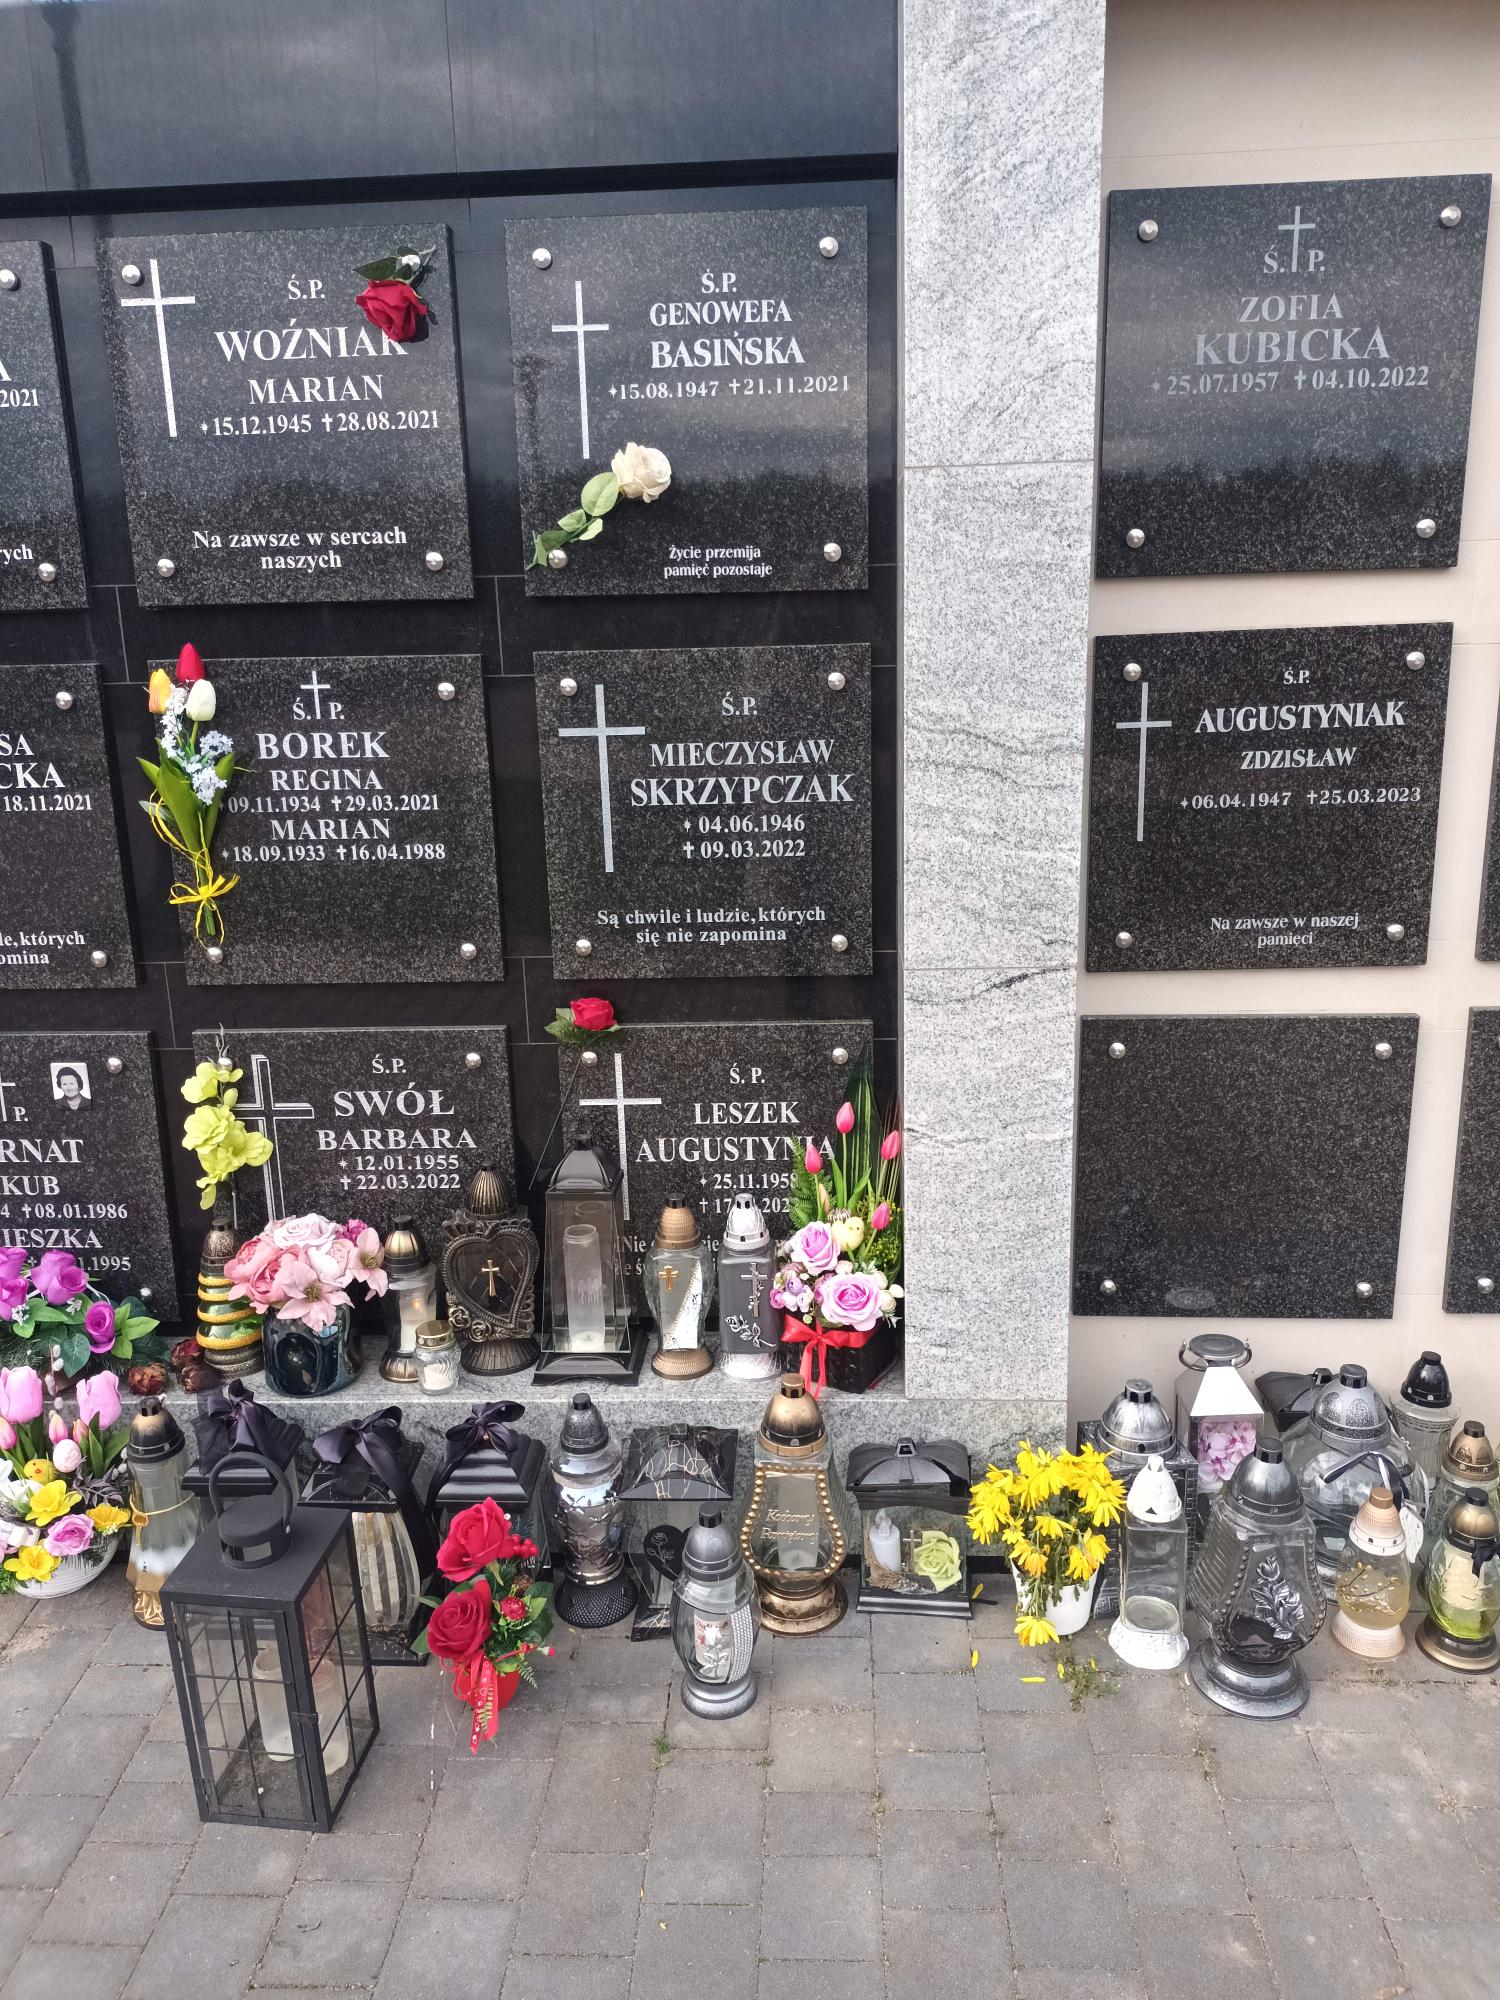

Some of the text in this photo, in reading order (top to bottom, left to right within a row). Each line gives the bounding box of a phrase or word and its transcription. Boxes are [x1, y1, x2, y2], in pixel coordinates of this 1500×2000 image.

[1263, 245, 1325, 274] Ś. P.
[287, 274, 326, 301] Ś.P.
[701, 268, 737, 294] Ś.P.
[649, 299, 792, 327] GENOWEFA
[1238, 293, 1344, 322] ZOFIA
[214, 318, 409, 362] WOŹNIAK
[651, 330, 805, 369] BASIŃSKA
[1194, 326, 1390, 366] KUBICKA
[248, 374, 384, 405] MARIAN
[620, 375, 849, 400] 15.08.1947 21.11.2021
[1166, 366, 1429, 395] 25.07.1957 04.10.2022
[212, 410, 440, 436] 15.12.1945 28.08.2021
[193, 527, 407, 549] Na zawsze w sercach
[0, 543, 34, 565] ych
[261, 552, 342, 573] naszych
[669, 545, 761, 563] Życie przemija
[664, 562, 772, 579] pamięć pozostaje
[1283, 667, 1310, 685] Ś.P.
[293, 697, 345, 721] Ś. P.
[721, 691, 758, 716] Ś.P.
[1195, 701, 1405, 733] AUGUSTYNIAK
[256, 731, 390, 760] BOREK
[649, 739, 834, 767] MIECZYSŁAW
[1241, 747, 1357, 770] ZDZISŁAW
[271, 770, 383, 791] REGINA
[631, 774, 854, 808] SKRZYPCZAK
[2, 794, 94, 812] 18.11.2021
[228, 794, 439, 814] 09.11.1934 29.03.2021
[1192, 788, 1421, 809] 06.04.1947 25.03.2023
[271, 818, 391, 840] MARIAN
[698, 814, 805, 834] 04.06.1946
[233, 843, 446, 863] 18.09.1933 16.04.1988
[700, 839, 806, 859] 09.03.2022
[598, 907, 826, 929] Są chwile i ludzie, których
[1211, 912, 1359, 931] Na zawsze w naszej
[19, 930, 86, 949] których
[636, 928, 786, 945] się nie zapomina
[1257, 932, 1313, 948] pamięci
[371, 1054, 407, 1074] Ś.P.
[729, 1062, 764, 1084] Ś. P.
[334, 1082, 454, 1117] SWÓŁ
[14, 1106, 29, 1122] P.
[694, 1102, 800, 1124] LESZEK
[317, 1129, 477, 1151] BARBARA
[636, 1136, 835, 1163] AUGUSTYNA
[355, 1155, 459, 1171] 12.01.1955
[0, 1175, 60, 1196] KUB
[357, 1174, 460, 1191] 22.03.2022
[34, 1203, 128, 1219] 08.01.1986
[78, 1256, 132, 1271] 1.1995
